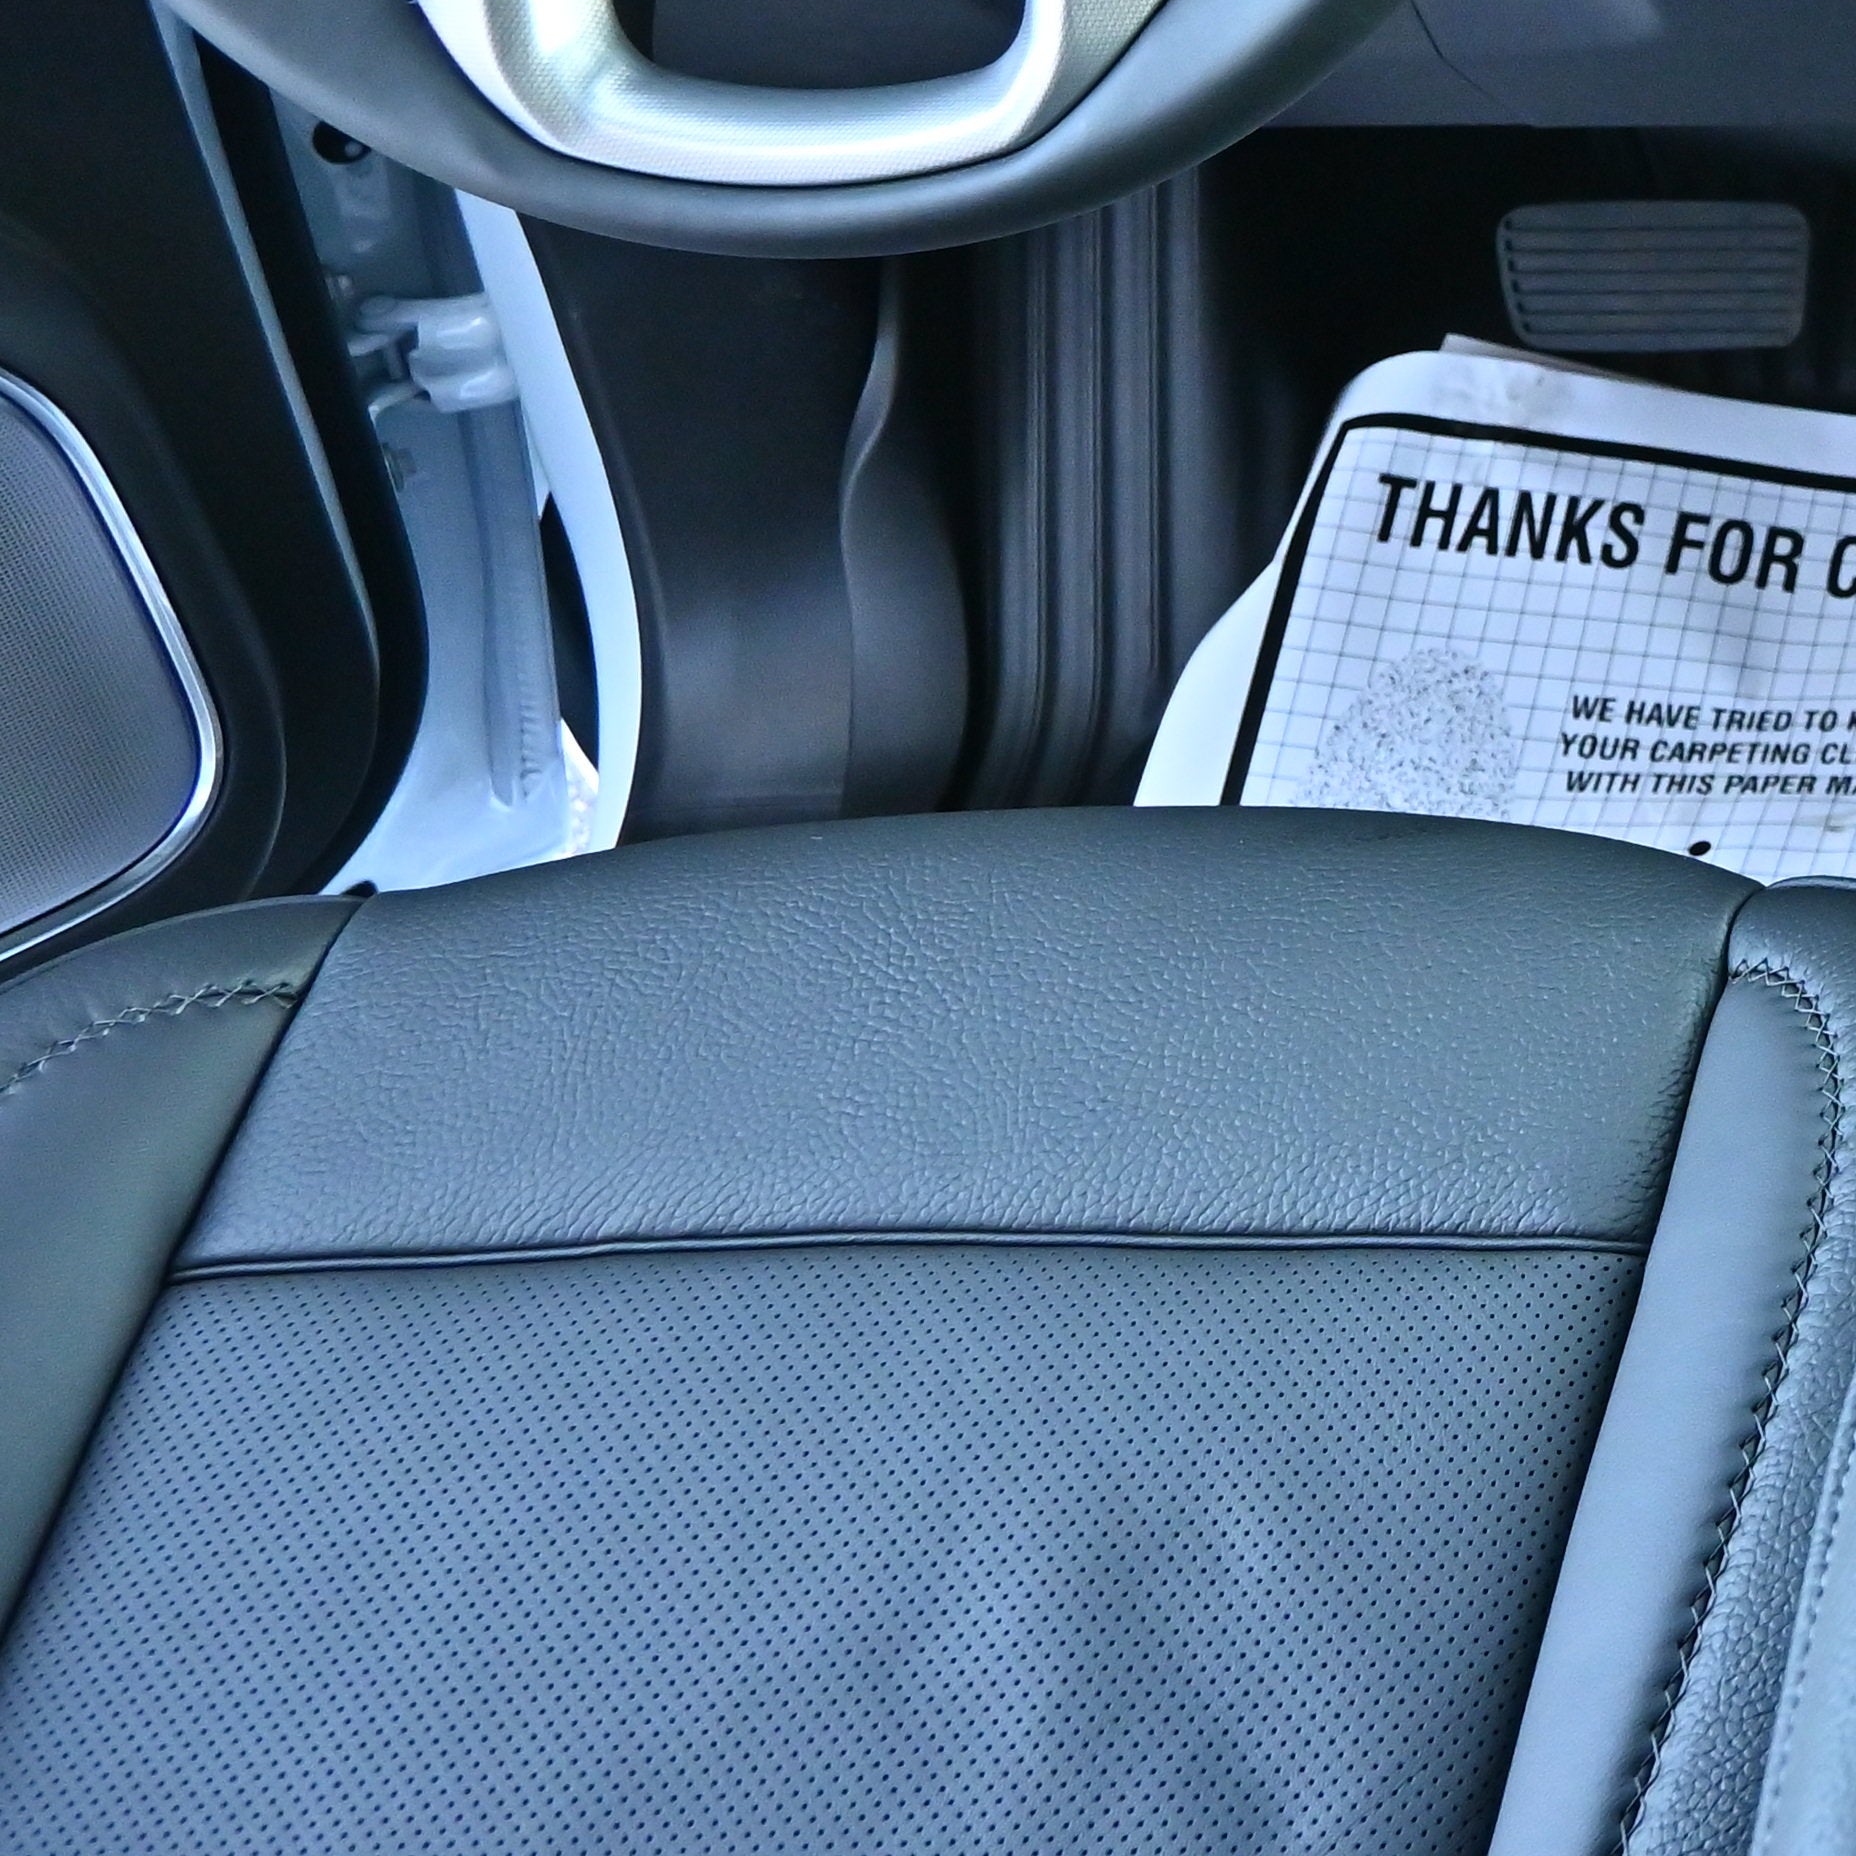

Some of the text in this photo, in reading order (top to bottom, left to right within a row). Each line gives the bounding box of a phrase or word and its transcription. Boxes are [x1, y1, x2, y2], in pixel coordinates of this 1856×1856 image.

[1377, 473, 1645, 569] THANKS
[1665, 511, 1804, 593] FOR
[1571, 695, 1616, 723] WE
[1624, 699, 1701, 731] HAVE
[1710, 707, 1793, 733] TRIED
[1803, 708, 1838, 732] TO
[1559, 732, 1641, 762] YOUR
[1649, 738, 1810, 766] CARPETING
[1565, 770, 1641, 794] WITH
[1651, 771, 1715, 795] THIS
[1724, 774, 1818, 796] PAPER
